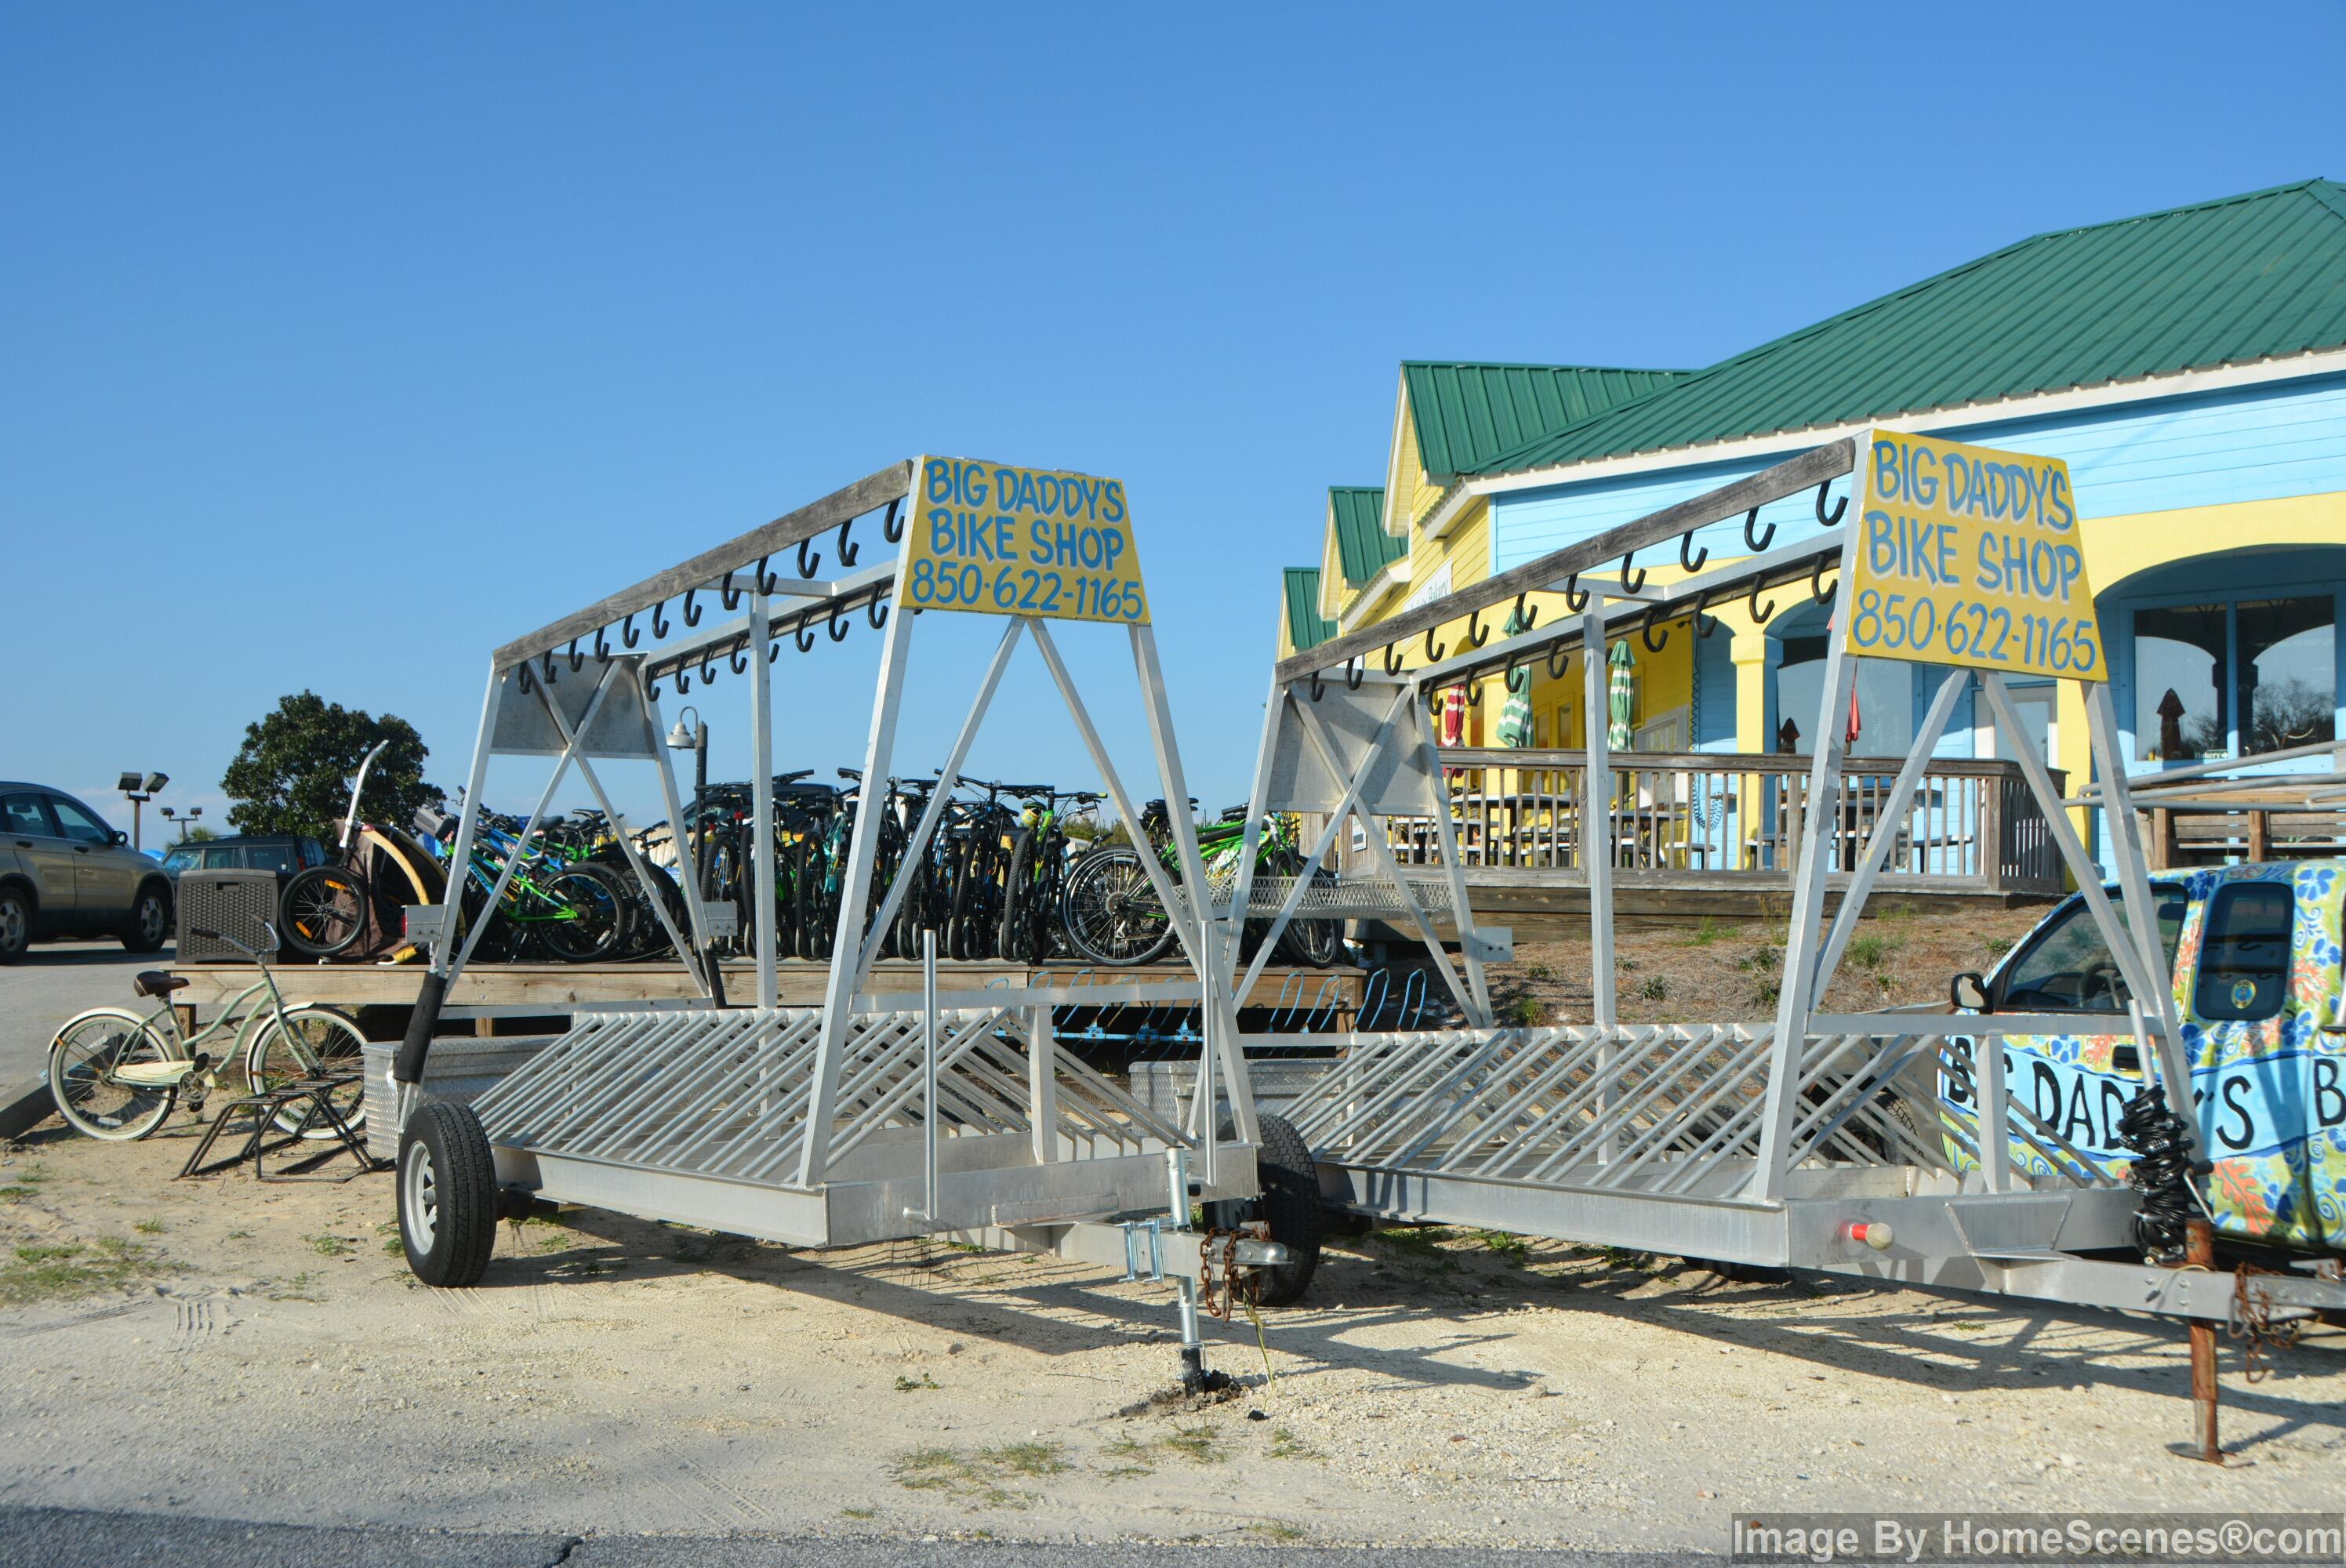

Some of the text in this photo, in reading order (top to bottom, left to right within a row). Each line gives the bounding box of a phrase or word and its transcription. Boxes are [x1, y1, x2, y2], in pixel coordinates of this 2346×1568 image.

[924, 459, 1124, 523] BIG DADDY'S
[1872, 440, 2073, 531] BIG DADDY'S
[928, 507, 1124, 571] BIKE SHOP
[1864, 510, 2081, 601] BIKE SHOP
[2033, 1062, 2254, 1150] DAD'S
